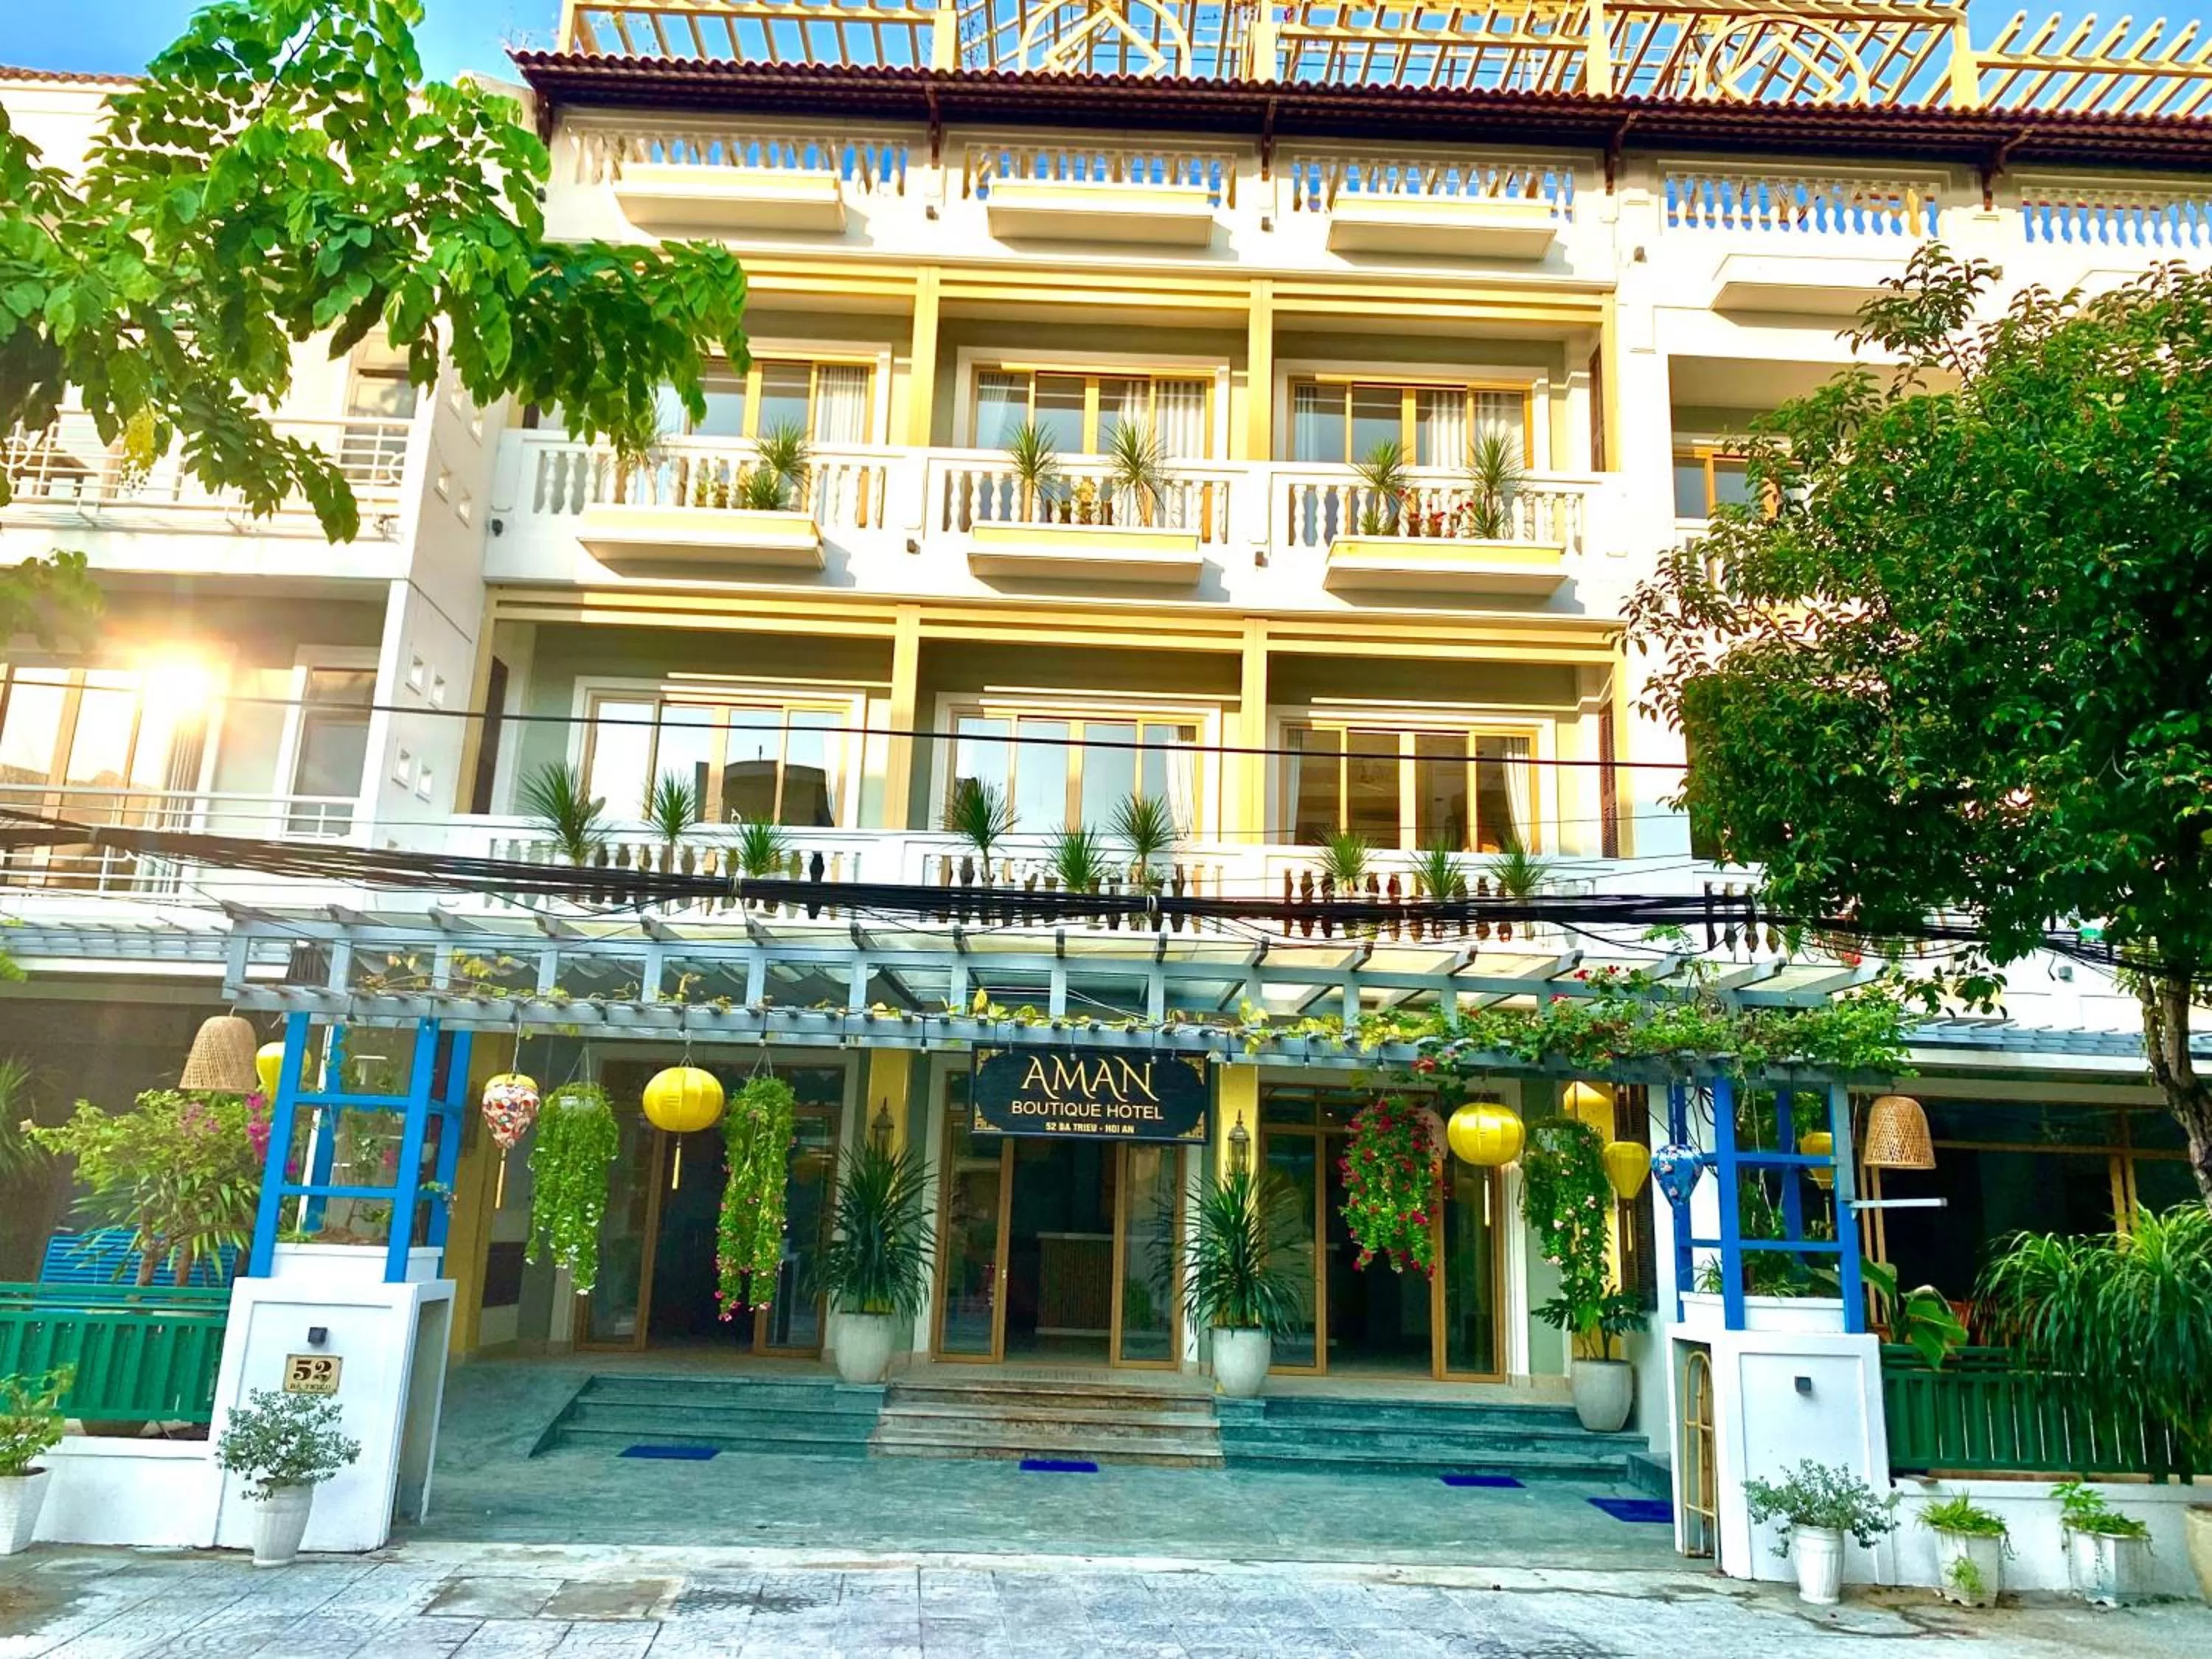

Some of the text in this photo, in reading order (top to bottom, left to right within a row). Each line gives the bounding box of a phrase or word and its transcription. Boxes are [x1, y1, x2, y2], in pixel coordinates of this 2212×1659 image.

[1020, 1054, 1160, 1102] AMAN
[1012, 1100, 1164, 1120] BOUTIQUE HOTEL
[1046, 1121, 1056, 1130] 52
[1073, 1123, 1097, 1132] TRIEU
[1105, 1124, 1119, 1133] HOI
[1121, 1124, 1135, 1133] AN
[293, 1360, 332, 1382] 52
